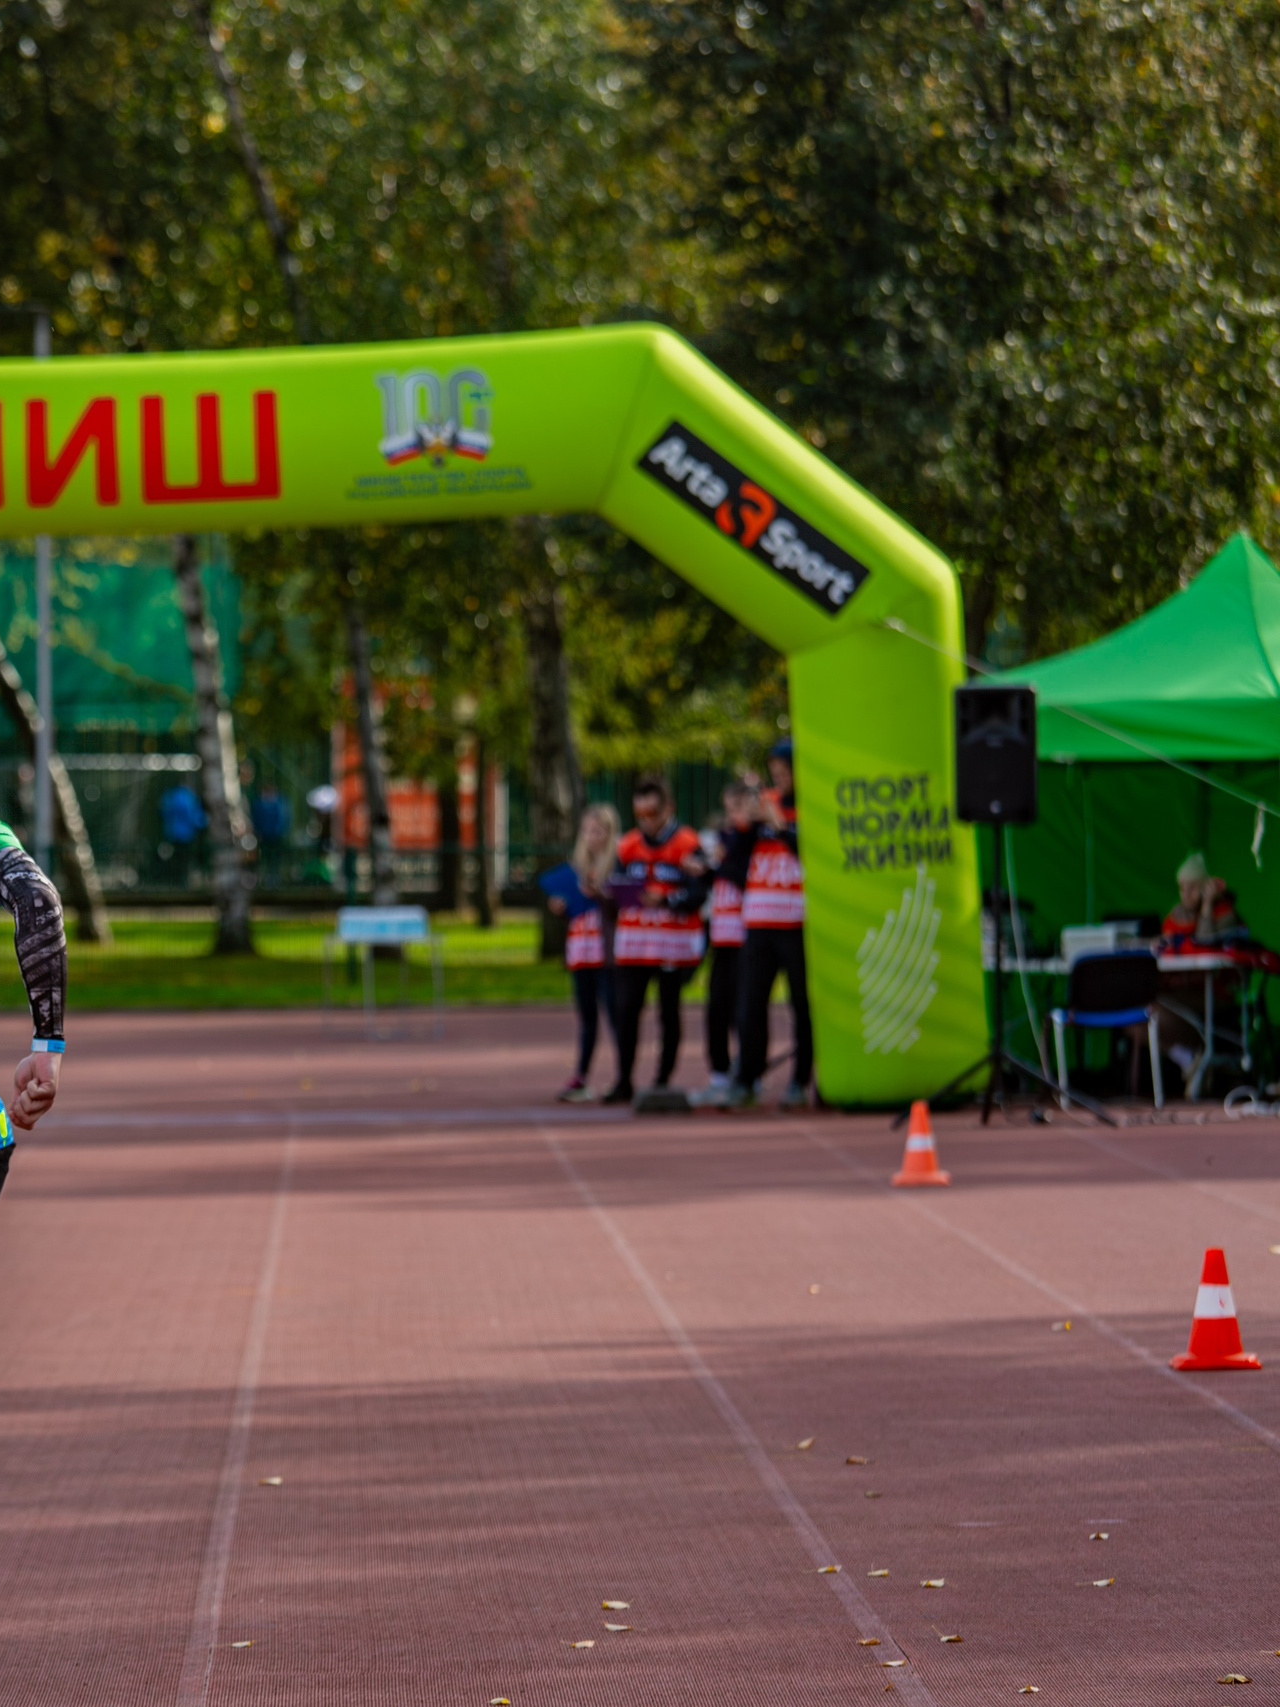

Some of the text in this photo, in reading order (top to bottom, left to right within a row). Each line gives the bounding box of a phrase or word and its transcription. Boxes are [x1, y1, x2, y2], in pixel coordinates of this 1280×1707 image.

[647, 435, 856, 606] Arta Sport
[835, 773, 929, 809] СПОРТ
[837, 806, 950, 842] НОРМА
[842, 839, 952, 872] ЖИЗНИ
